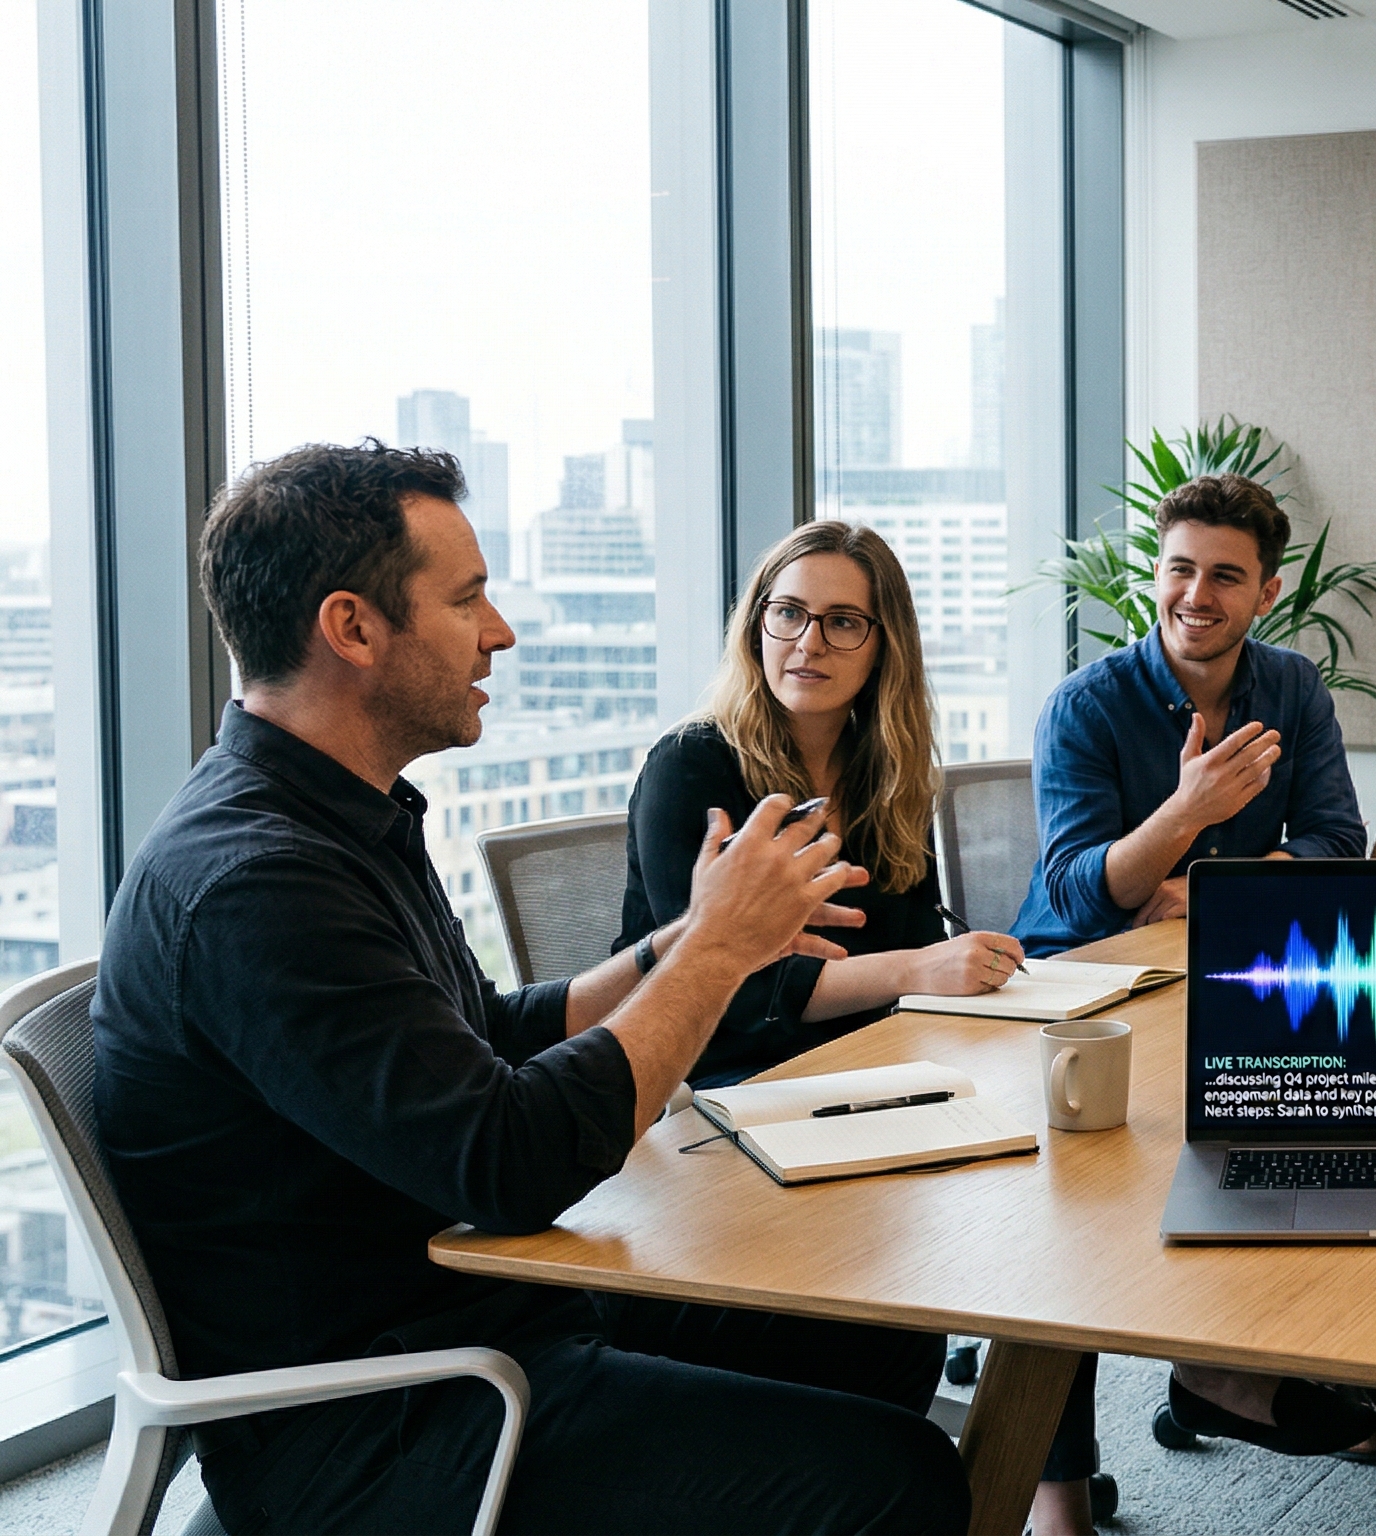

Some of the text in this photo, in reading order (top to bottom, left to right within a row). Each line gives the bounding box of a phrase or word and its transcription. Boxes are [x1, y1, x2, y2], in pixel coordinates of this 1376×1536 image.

[1204, 1056, 1347, 1069] LIVE TRANSCRIPTION:
[1204, 1072, 1282, 1089] ...discussing
[1284, 1072, 1303, 1086] Q4
[1305, 1072, 1350, 1088] project
[1313, 1087, 1337, 1101] and
[1236, 1104, 1275, 1119] steps:
[1276, 1103, 1313, 1117] Sarah
[1315, 1104, 1329, 1117] to
